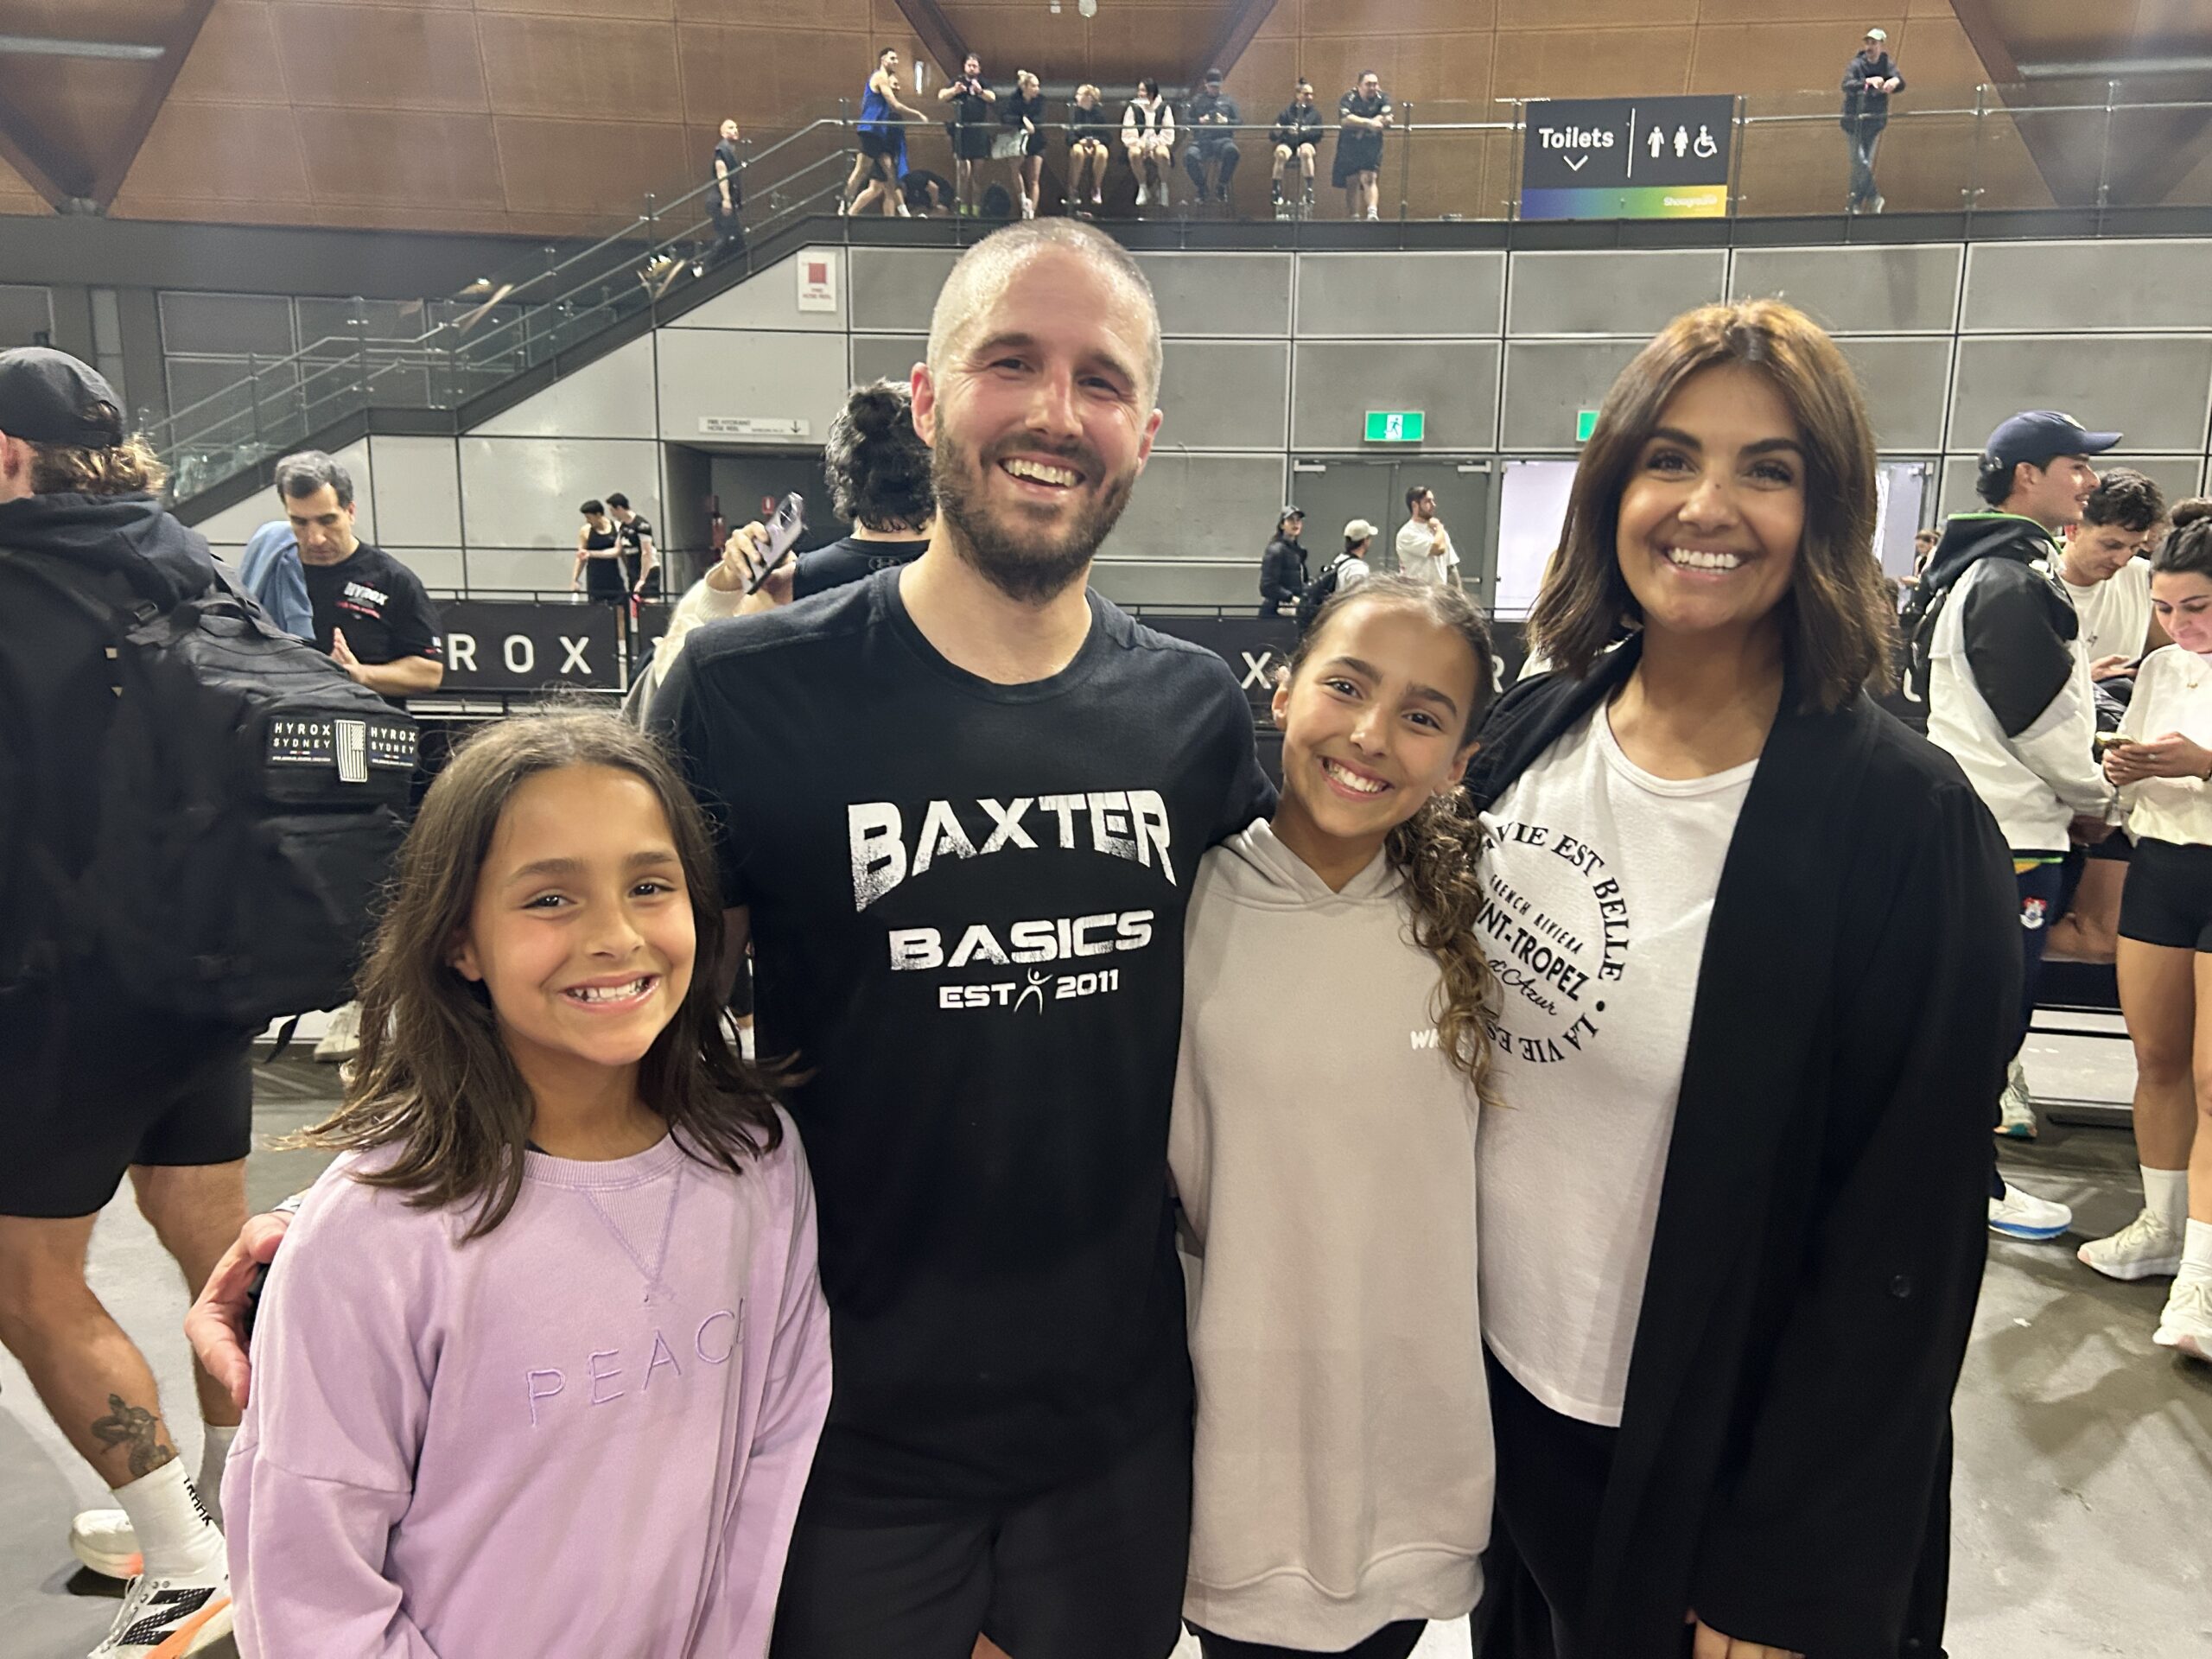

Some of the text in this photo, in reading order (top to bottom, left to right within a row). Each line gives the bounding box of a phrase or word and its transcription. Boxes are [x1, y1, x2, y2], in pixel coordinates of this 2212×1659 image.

[1539, 126, 1614, 149] Toilets
[273, 737, 331, 749] SYDNEY
[275, 722, 331, 736] HYROX
[371, 727, 416, 742] HYROX
[371, 741, 414, 754] SYDNEY
[848, 790, 1177, 912] BAXTER
[1490, 874, 1584, 955] FRENCH RIVIERA
[888, 910, 1154, 971] BASICS
[1486, 821, 1630, 1064] VIE EST BELLE LA VIE ES
[939, 969, 1120, 1009] EST 2011
